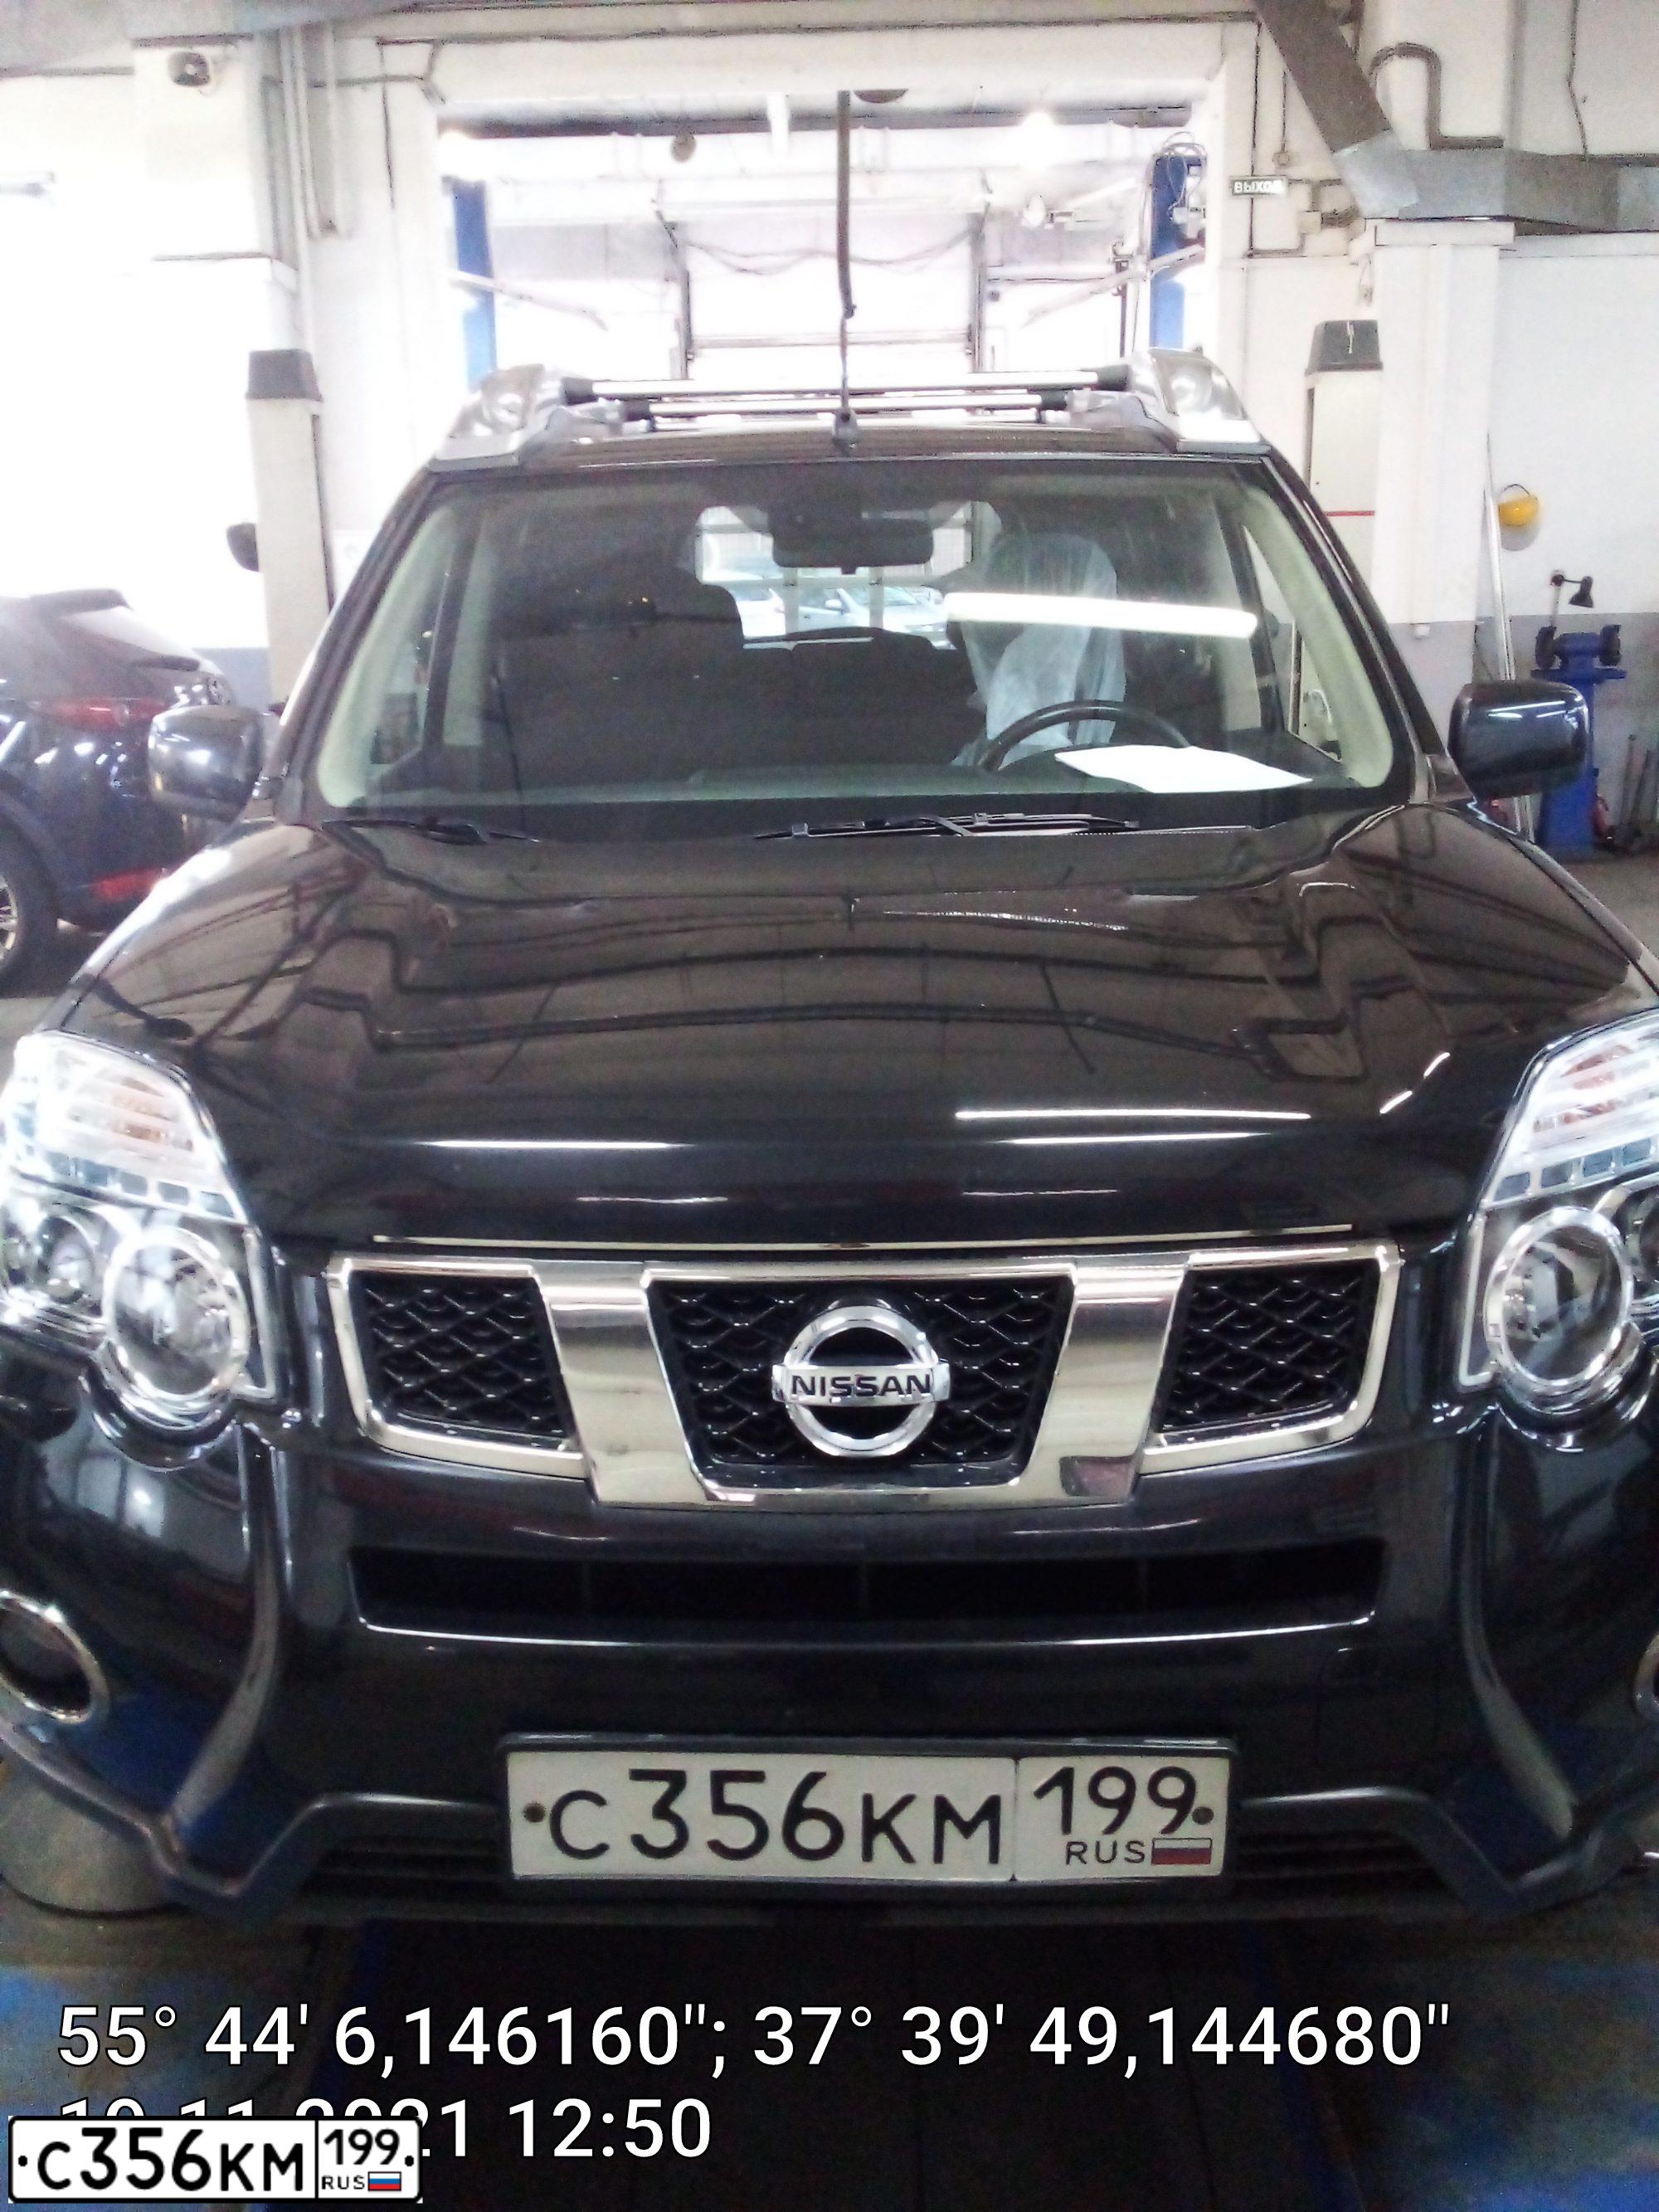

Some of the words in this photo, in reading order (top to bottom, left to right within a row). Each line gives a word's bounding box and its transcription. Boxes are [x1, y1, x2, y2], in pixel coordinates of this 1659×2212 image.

[791, 1374, 931, 1397] NISSAN
[1033, 1766, 1199, 1836] 199
[1065, 1839, 1146, 1866] RUS
